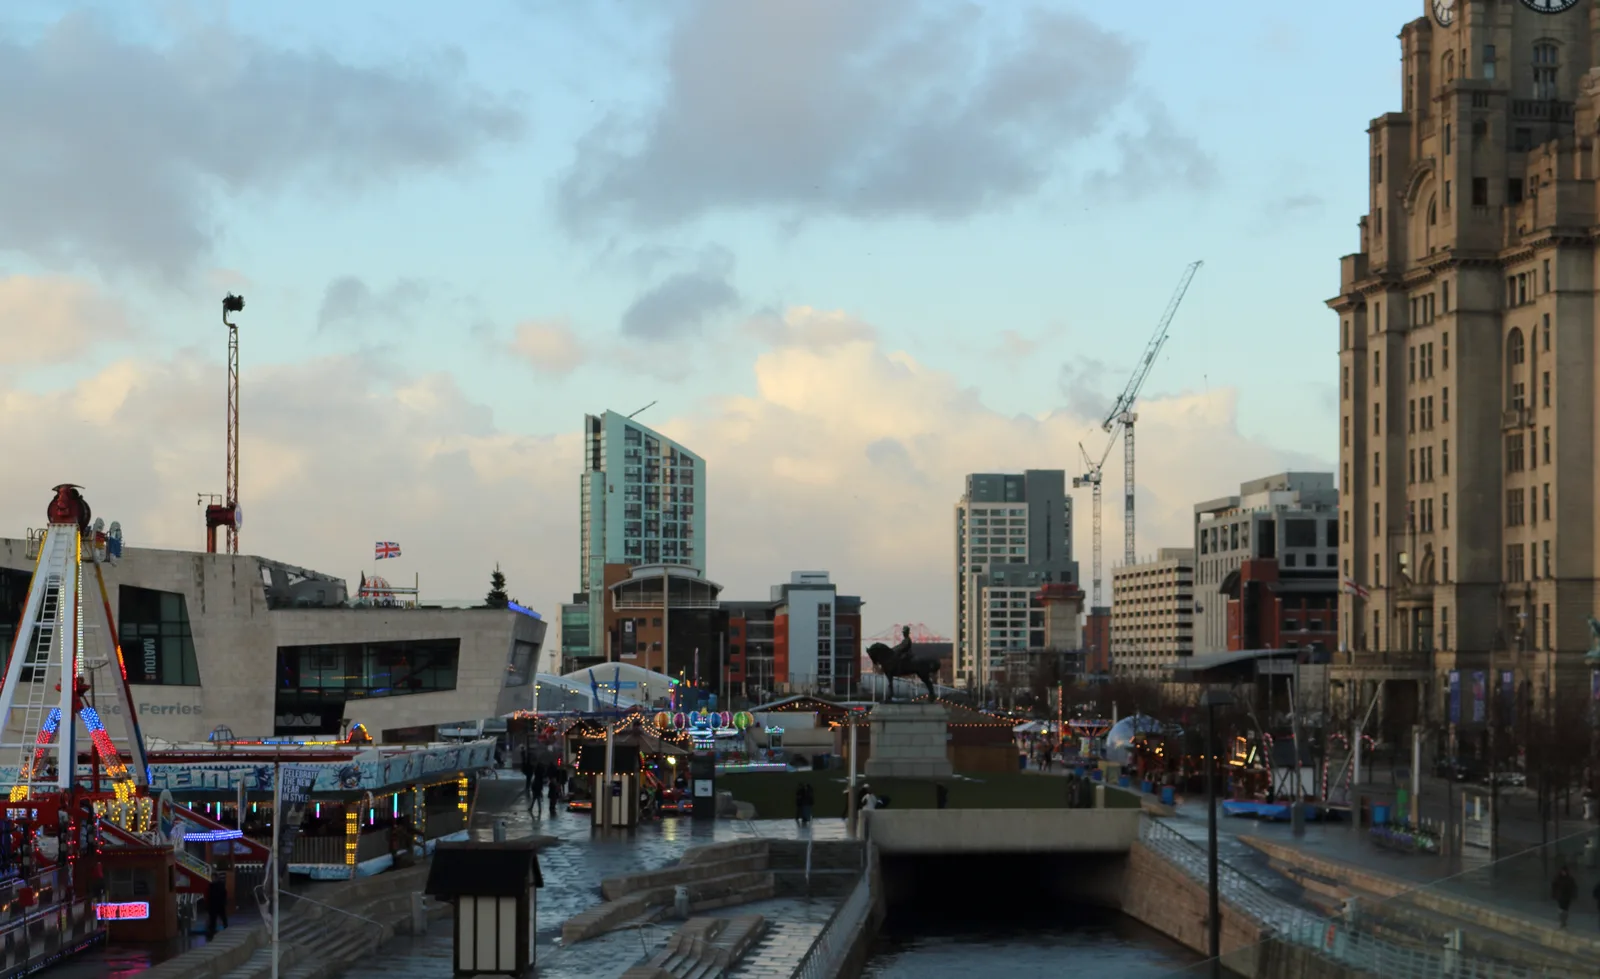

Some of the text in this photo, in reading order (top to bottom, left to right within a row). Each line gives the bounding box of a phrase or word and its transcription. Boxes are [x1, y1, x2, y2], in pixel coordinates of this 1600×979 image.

[144, 638, 156, 674] MATOU
[139, 702, 203, 715] Ferries
[284, 777, 295, 785] THE
